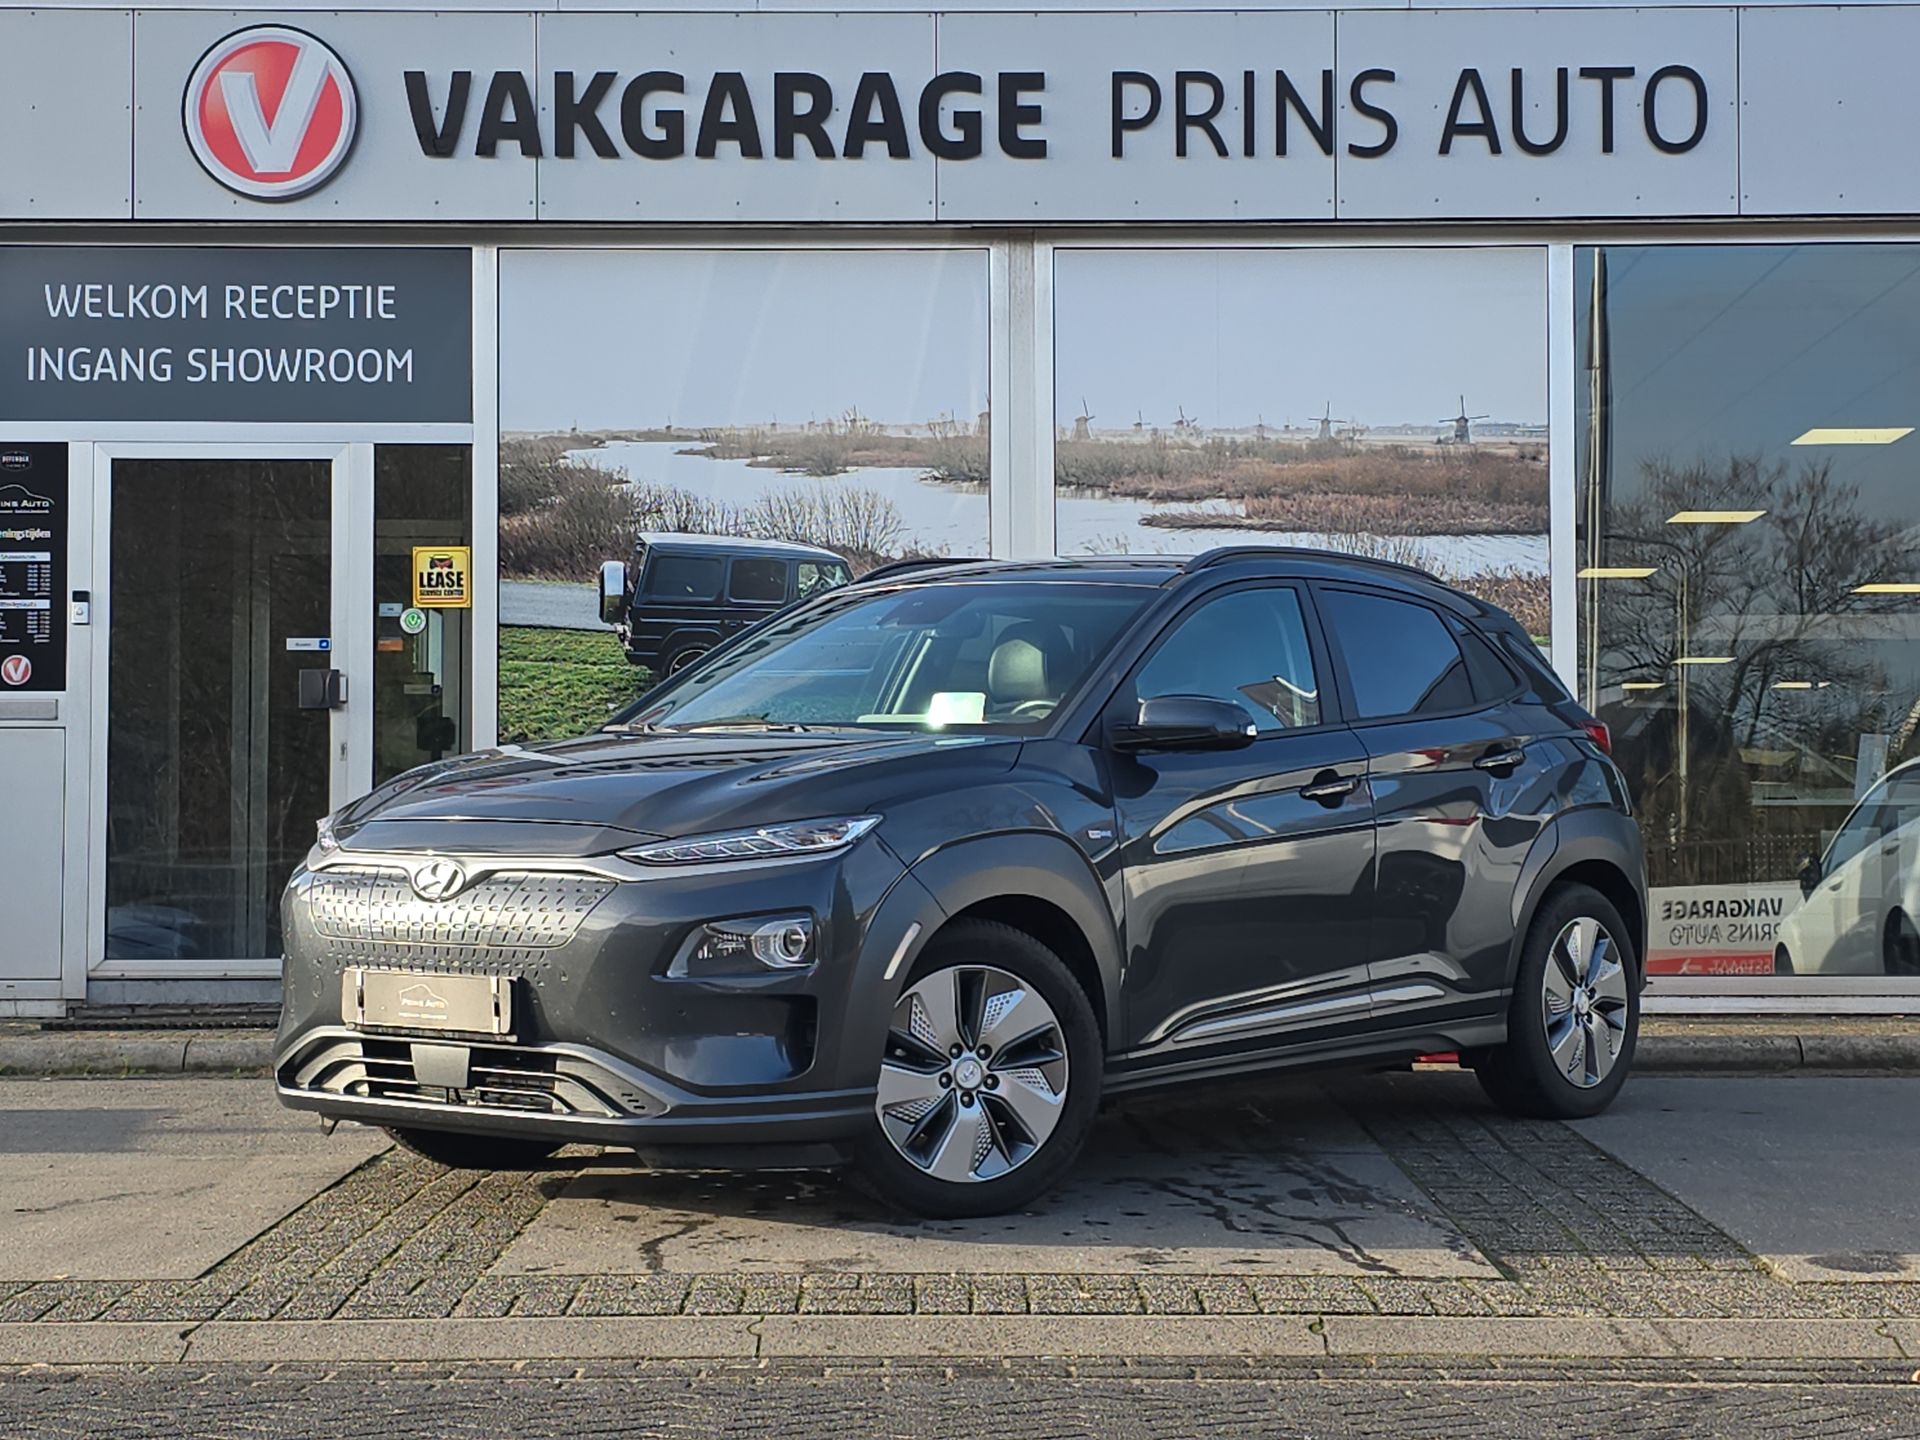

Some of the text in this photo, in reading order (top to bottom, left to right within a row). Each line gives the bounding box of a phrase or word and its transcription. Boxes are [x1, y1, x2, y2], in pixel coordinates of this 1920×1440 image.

[404, 64, 1709, 159] VAKGARAGE PRINS AUTO
[44, 284, 397, 320] WELKOM RECEPTIE
[27, 347, 414, 383] INGANG SHOWROOM
[0, 499, 50, 508] INS AUTO
[0, 527, 51, 541] ningstijden
[419, 571, 464, 588] LEASE
